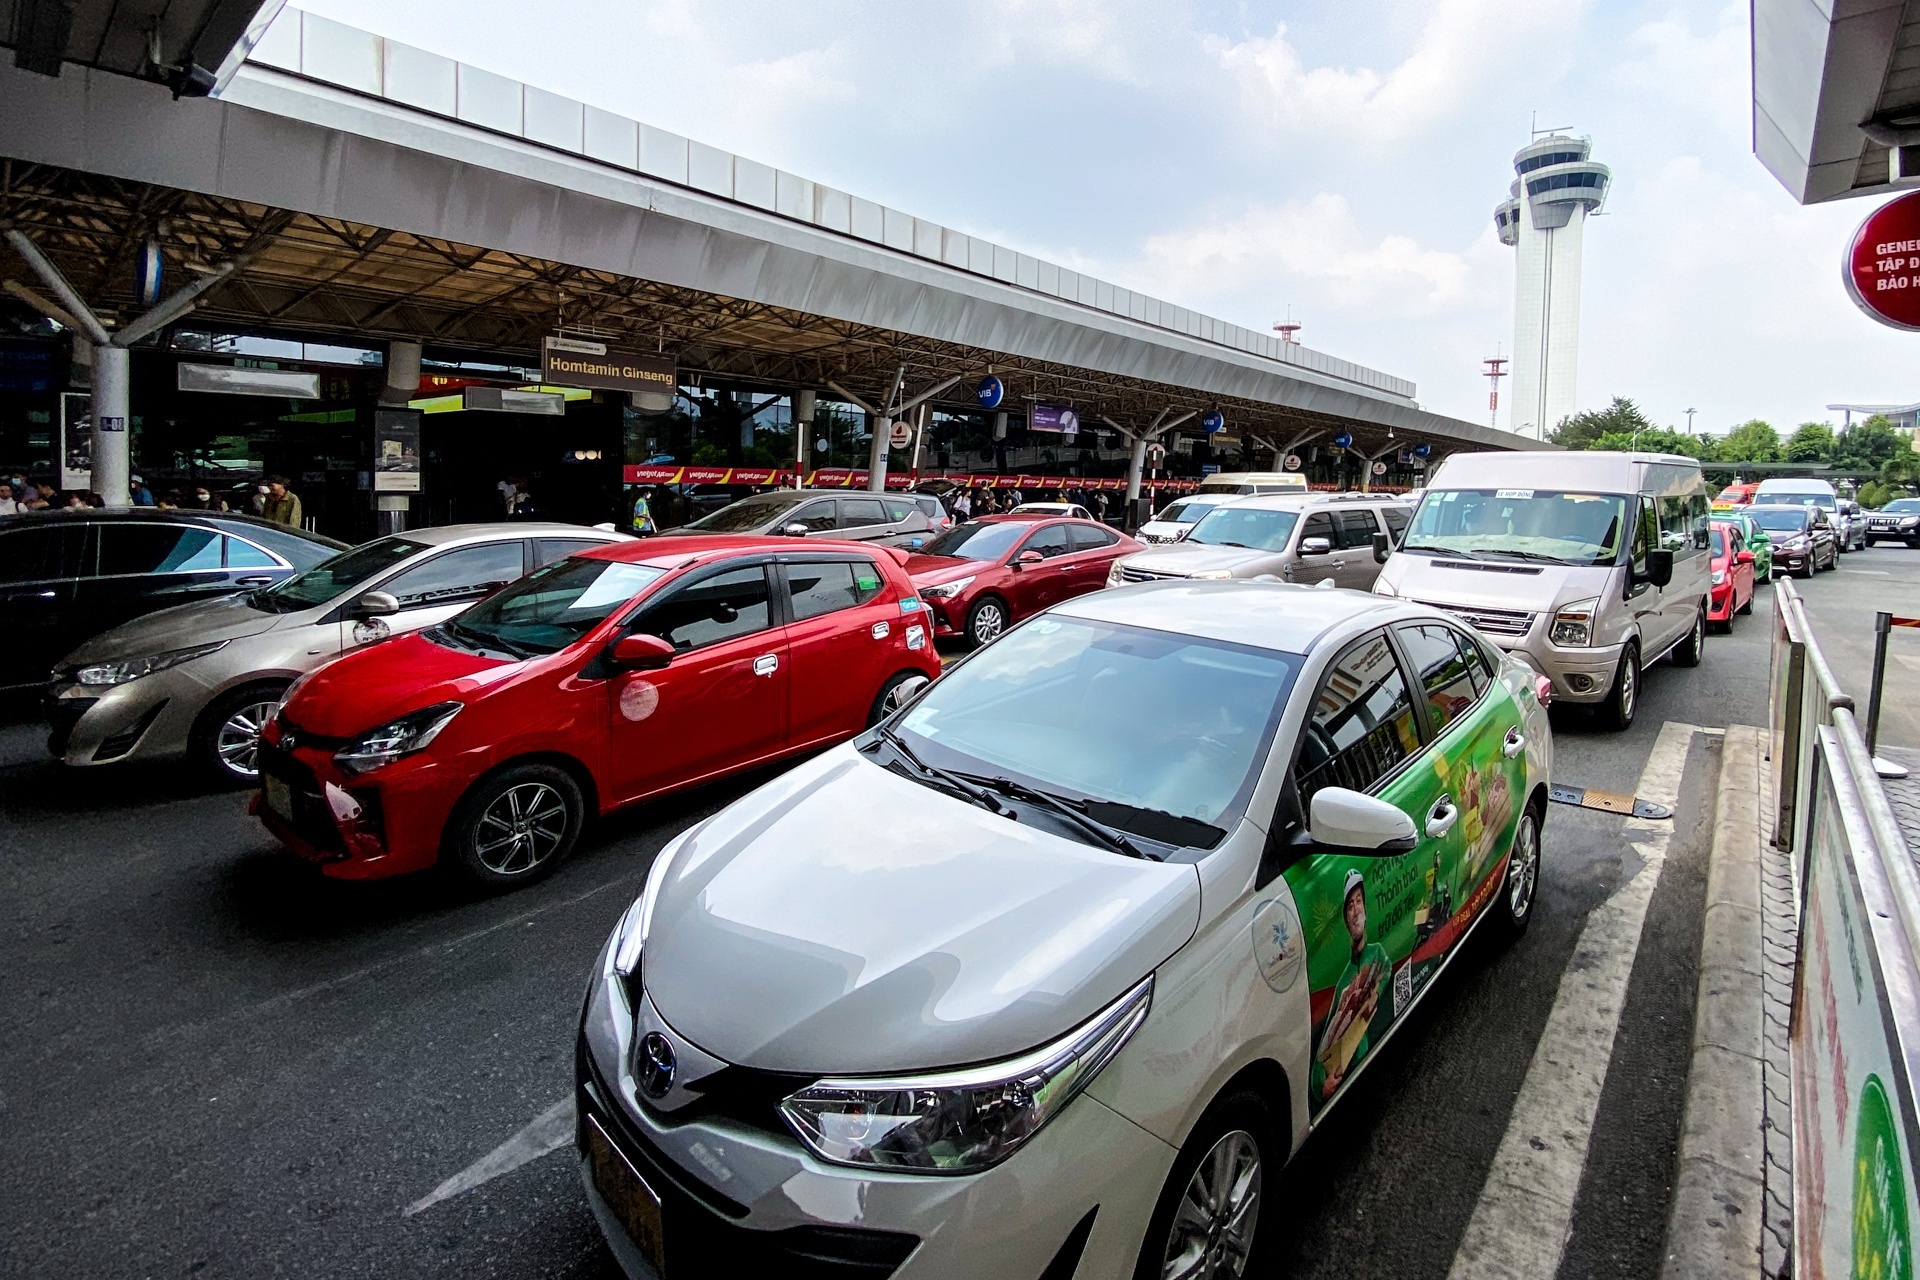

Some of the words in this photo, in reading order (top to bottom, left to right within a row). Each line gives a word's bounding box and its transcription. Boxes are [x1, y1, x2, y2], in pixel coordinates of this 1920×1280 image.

[1876, 257, 1905, 274] TẬP
[1876, 274, 1908, 291] BẢO
[550, 357, 620, 377] Homtamin
[622, 366, 673, 385] Ginseng
[978, 388, 992, 398] VIB
[902, 599, 917, 609] Grab
